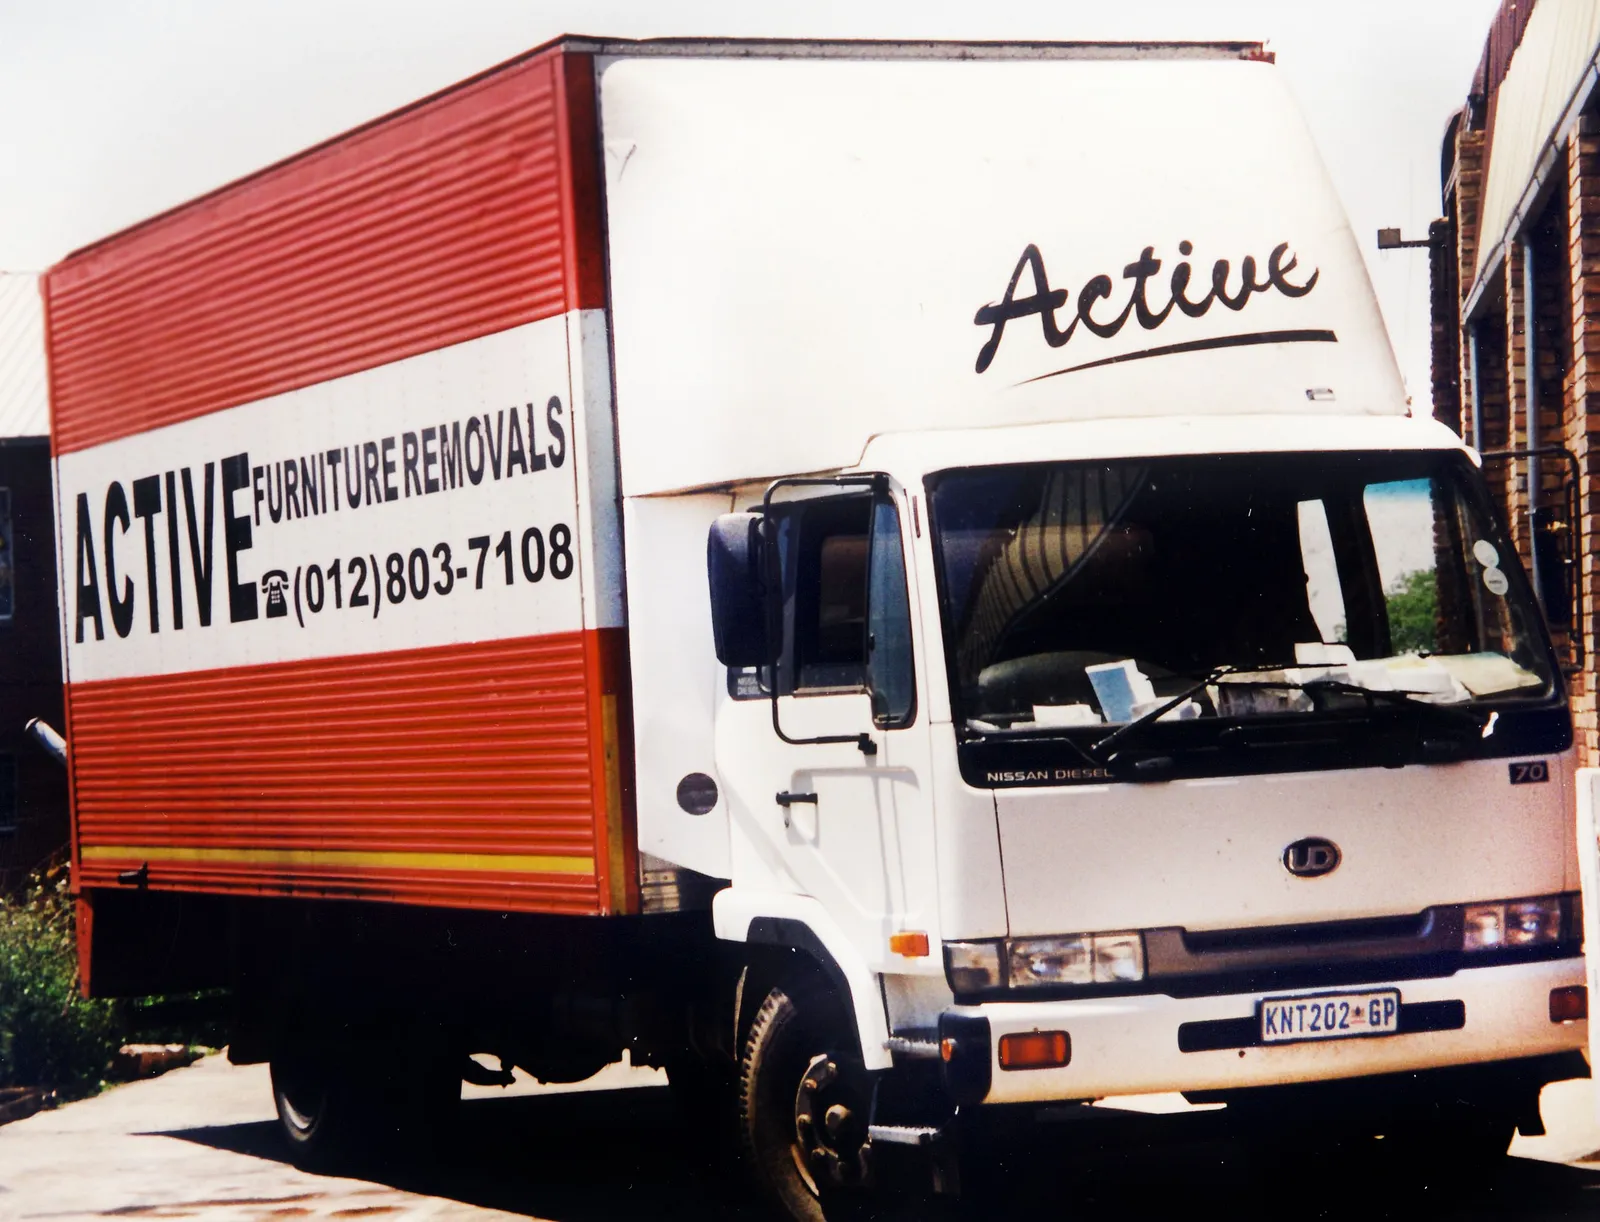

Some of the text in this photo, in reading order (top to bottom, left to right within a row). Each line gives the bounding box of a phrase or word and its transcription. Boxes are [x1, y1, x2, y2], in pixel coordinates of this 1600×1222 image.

[974, 240, 1319, 374] Active
[252, 395, 566, 526] FURNITURE REMOVALS
[75, 452, 258, 644] ACTIVE
[987, 768, 1114, 782] NISSAN DIESEL
[1515, 764, 1544, 781] 70
[1368, 997, 1395, 1027] GP
